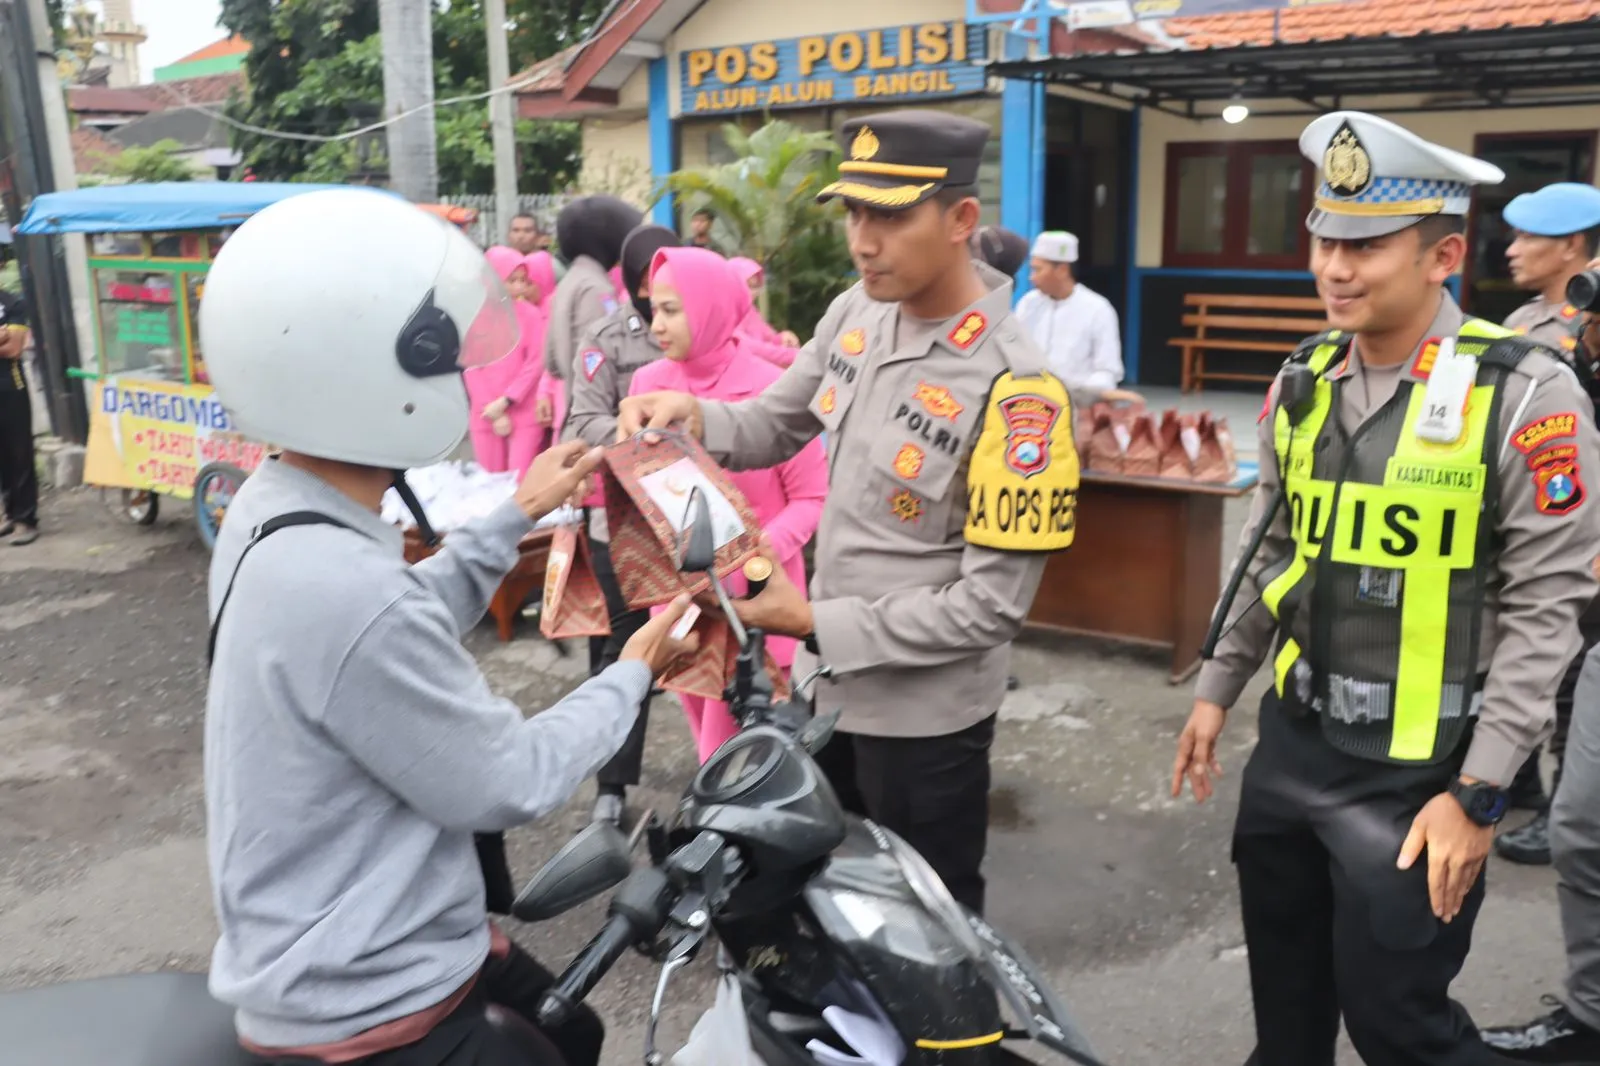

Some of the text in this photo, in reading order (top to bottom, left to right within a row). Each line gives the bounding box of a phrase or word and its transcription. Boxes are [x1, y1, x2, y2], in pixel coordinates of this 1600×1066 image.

[688, 22, 966, 87] POS POLISI
[696, 71, 955, 110] ALUN-ALUN BANGIL
[102, 386, 237, 432] DARGOMB
[895, 402, 960, 456] POLRI
[1429, 404, 1447, 418] 14
[1396, 465, 1474, 489] KASATLANTAS
[997, 487, 1041, 534] OPS
[1291, 491, 1457, 559] OLISI
